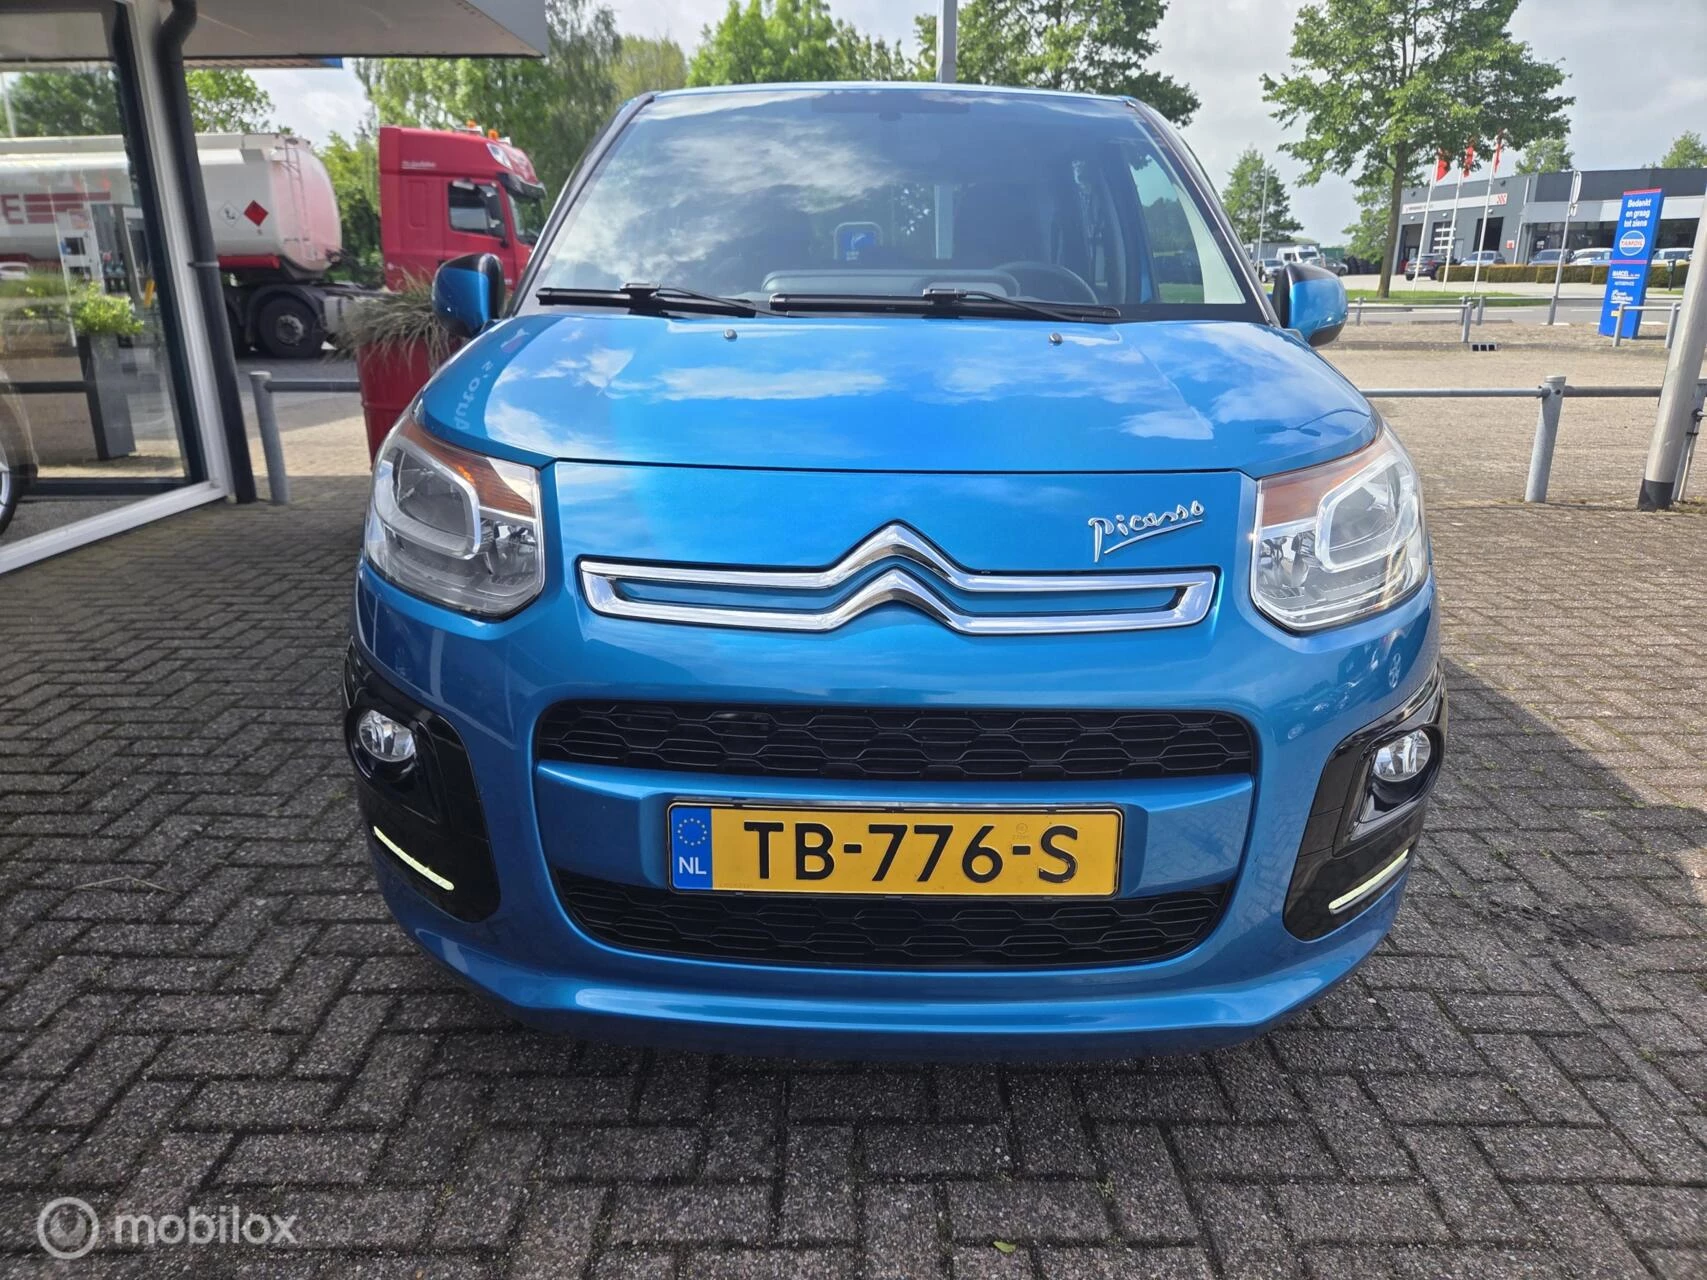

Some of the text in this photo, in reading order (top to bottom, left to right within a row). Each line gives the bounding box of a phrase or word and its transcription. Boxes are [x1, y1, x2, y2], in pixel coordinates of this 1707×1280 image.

[1633, 210, 1650, 218] graag
[1088, 500, 1205, 563] Picasso
[678, 856, 707, 876] NL
[743, 821, 1079, 884] TB-776-S
